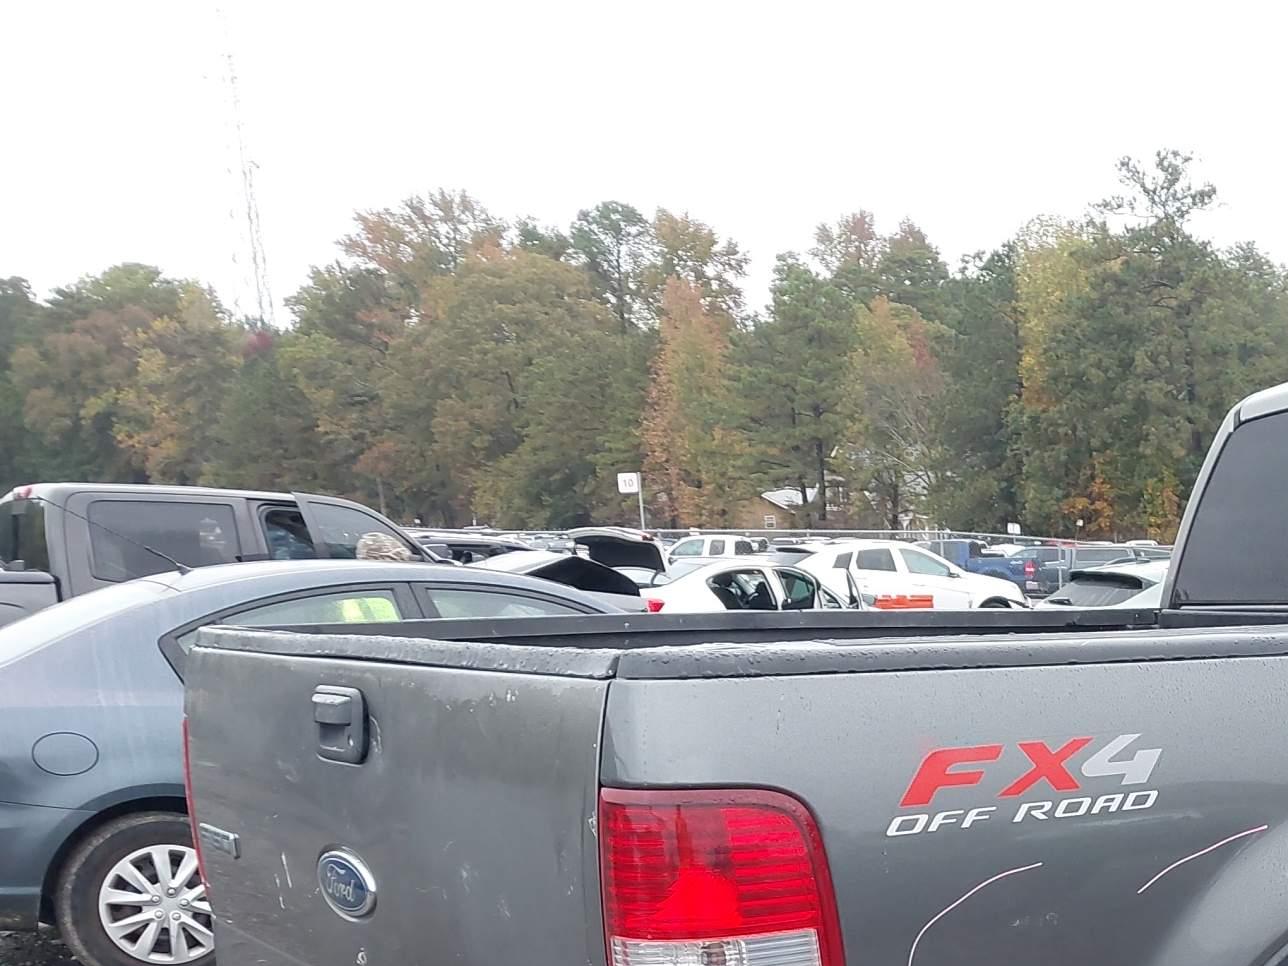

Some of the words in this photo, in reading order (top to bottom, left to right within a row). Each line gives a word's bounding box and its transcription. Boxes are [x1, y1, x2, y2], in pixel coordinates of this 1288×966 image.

[899, 733, 1163, 809] FX4
[885, 805, 998, 838] OFF
[1011, 789, 1160, 824] ROAD
[326, 863, 356, 902] Ford
